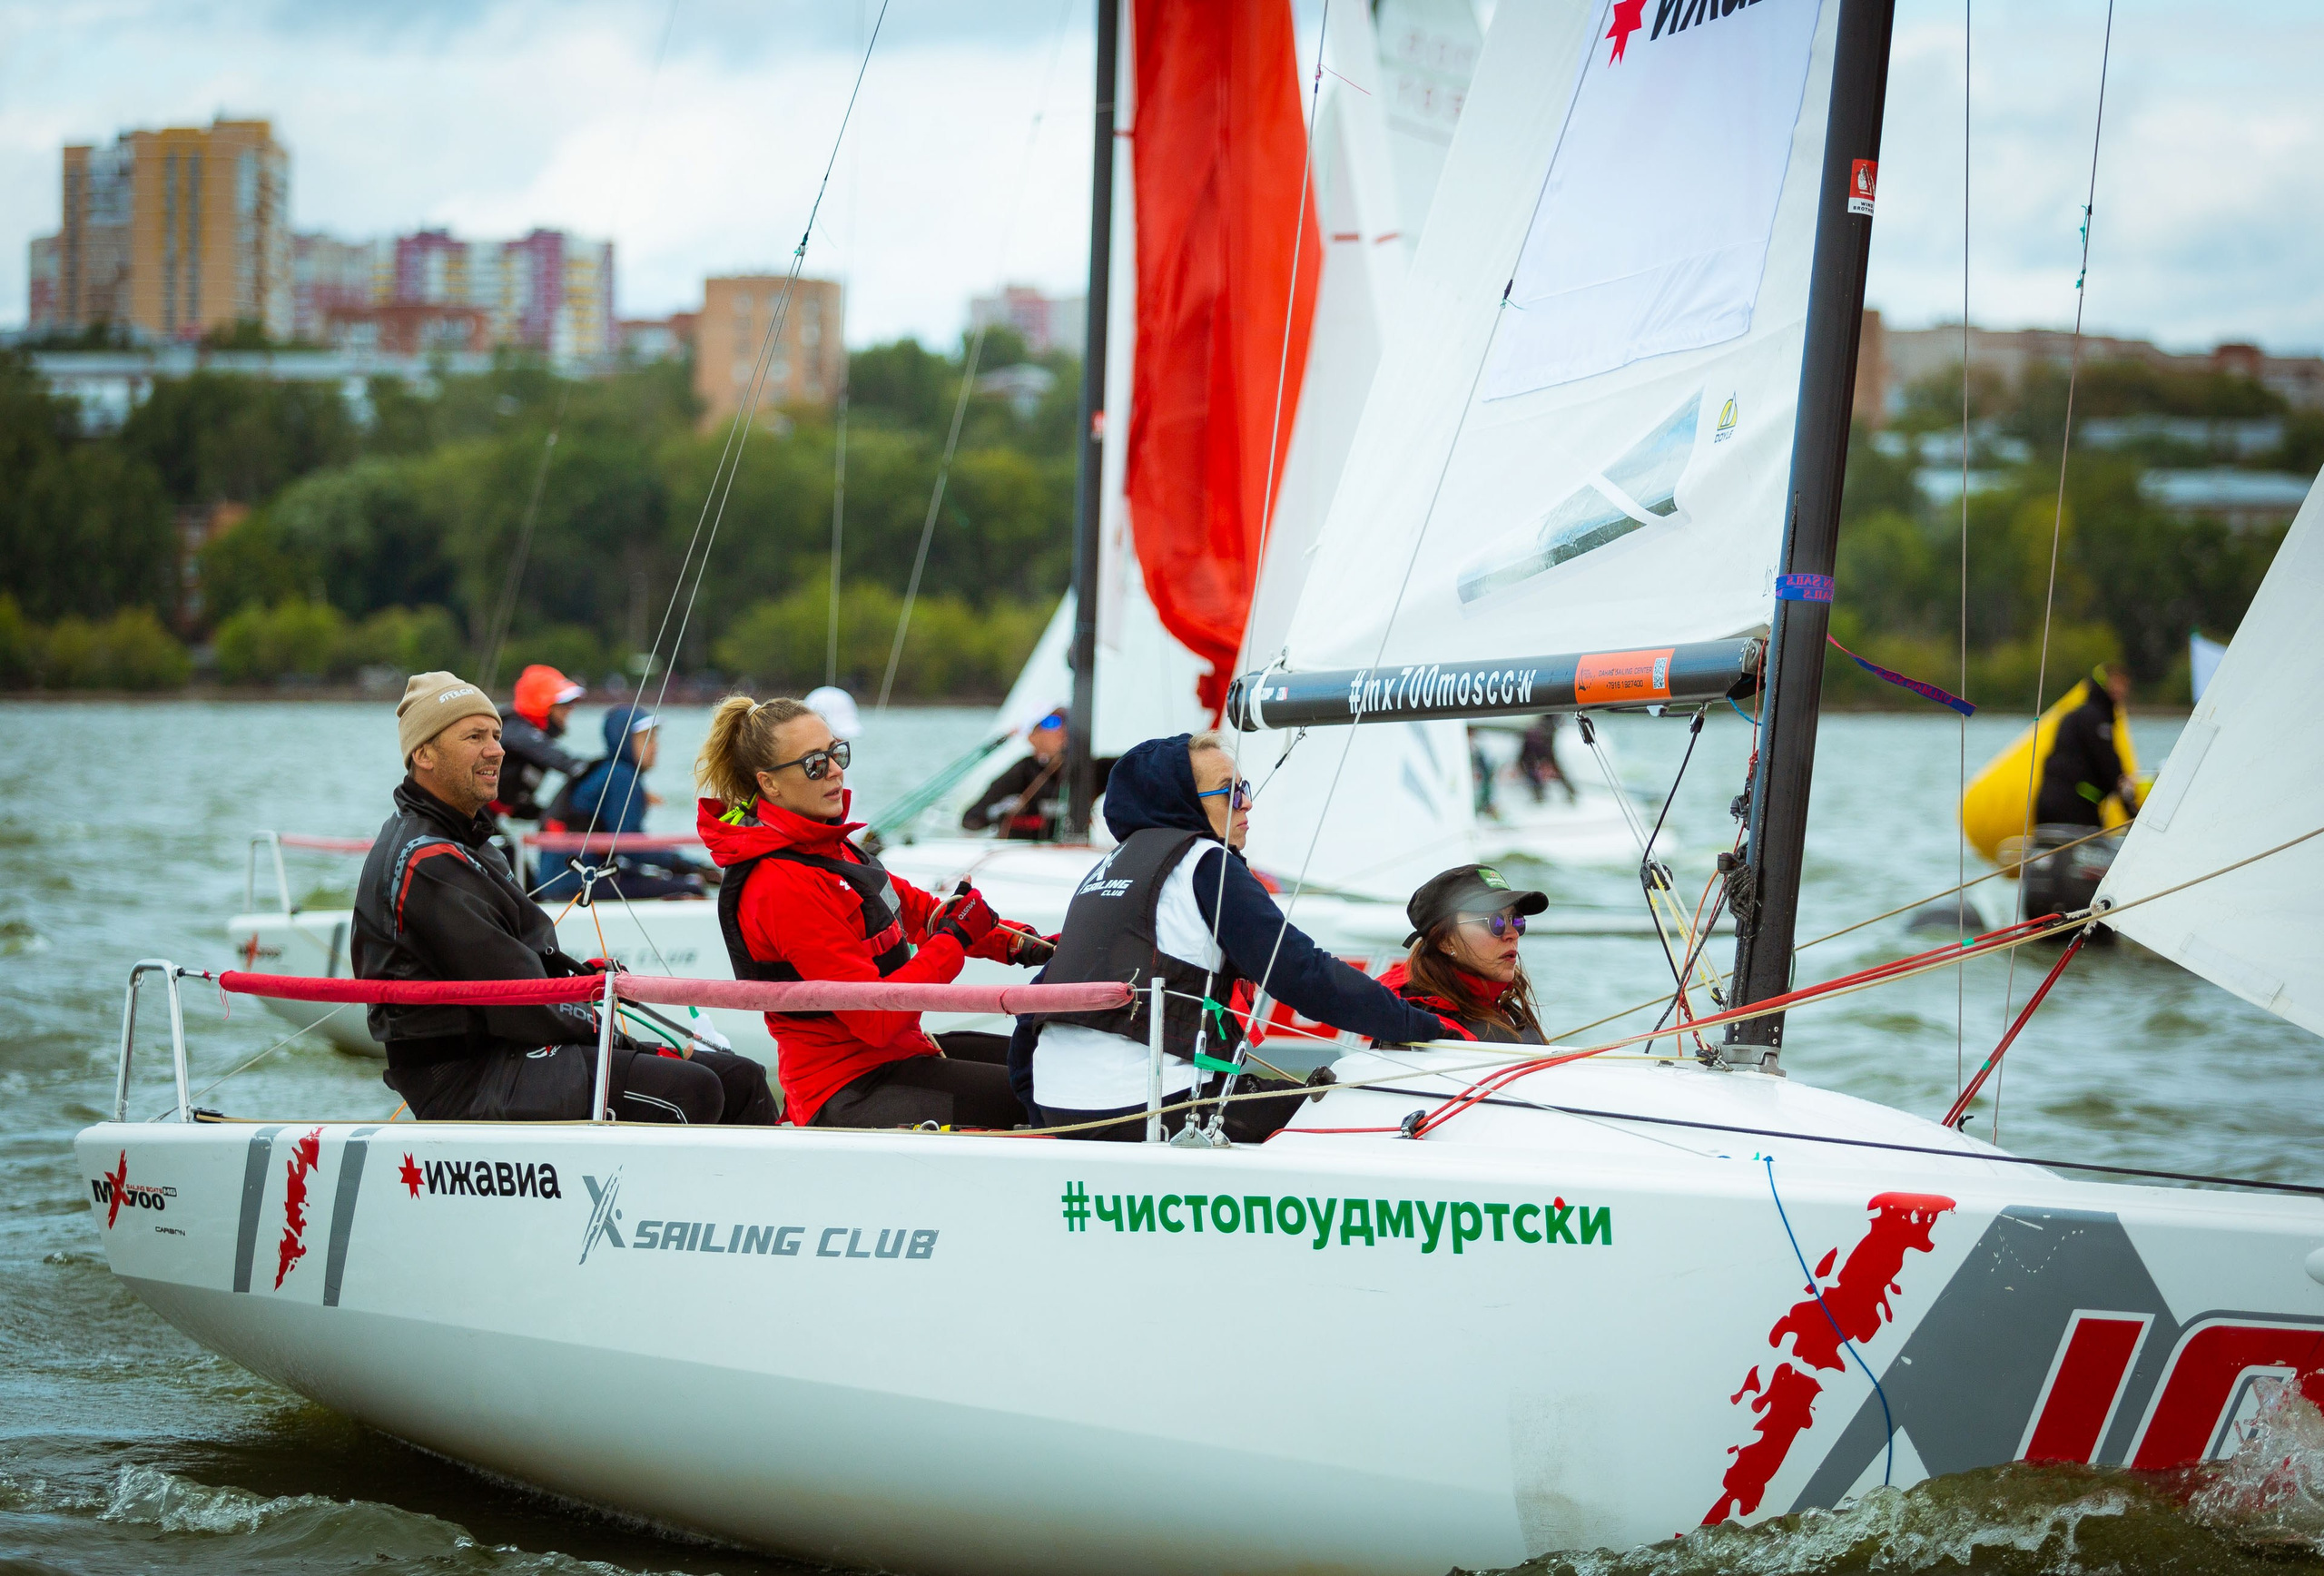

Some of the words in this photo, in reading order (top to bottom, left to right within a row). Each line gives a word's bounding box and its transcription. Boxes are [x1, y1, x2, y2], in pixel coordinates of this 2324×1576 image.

[1079, 879, 1134, 895] SAILING
[958, 898, 976, 921] MUSTO
[1061, 1180, 1612, 1255] #чистопоудмуртски
[633, 1220, 806, 1256] SAILING
[816, 1226, 940, 1260] CLUB
